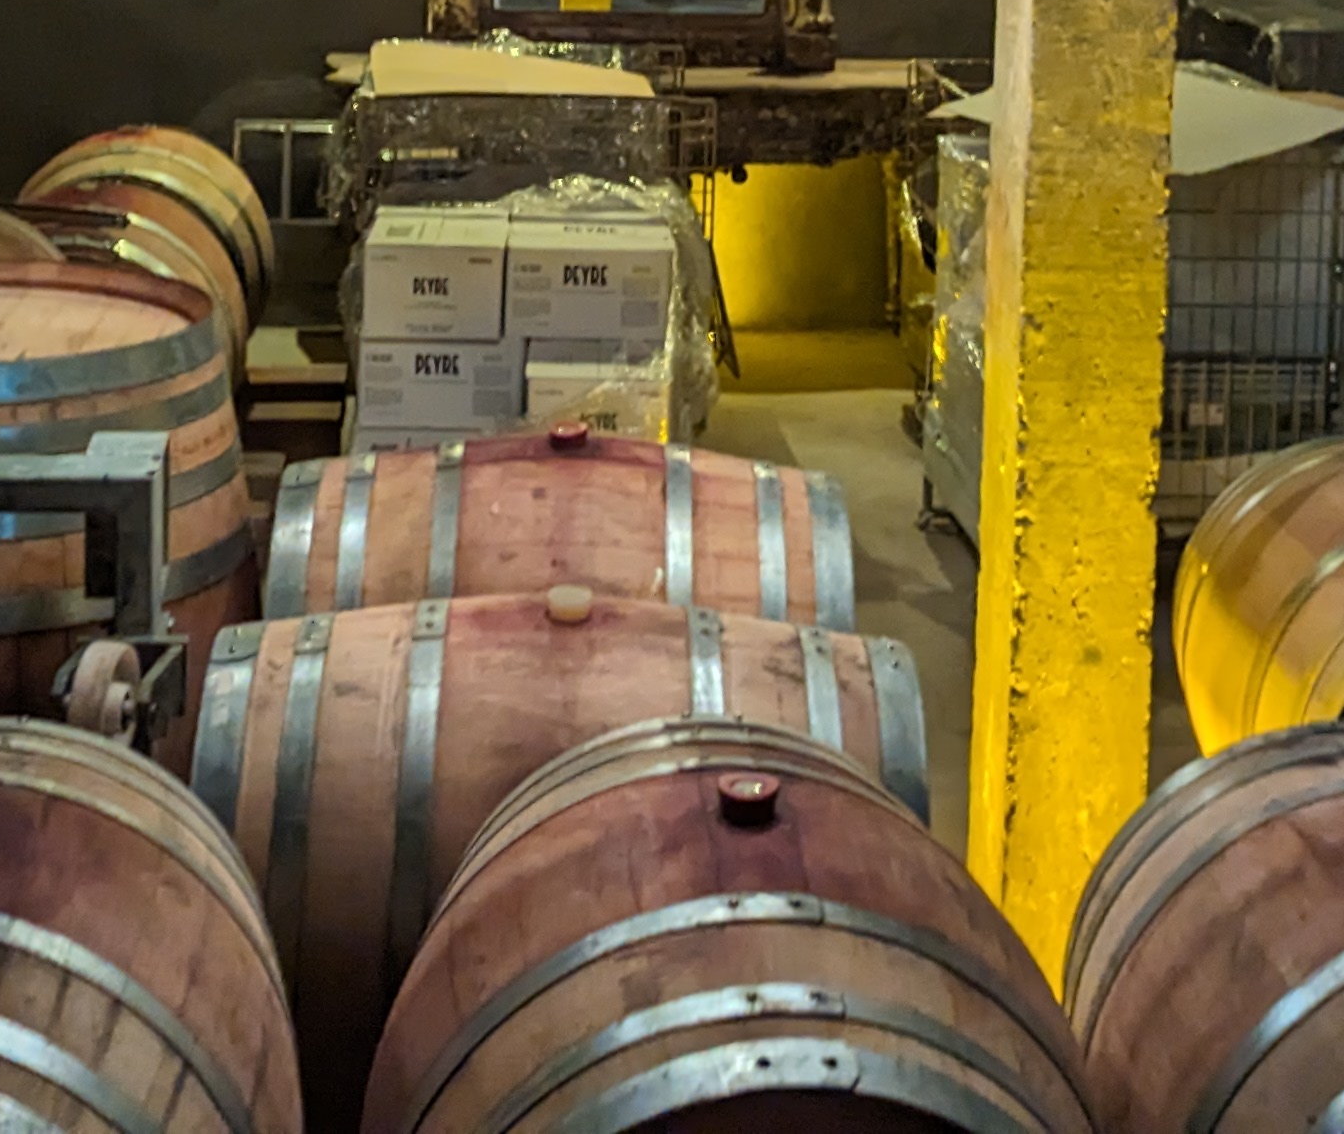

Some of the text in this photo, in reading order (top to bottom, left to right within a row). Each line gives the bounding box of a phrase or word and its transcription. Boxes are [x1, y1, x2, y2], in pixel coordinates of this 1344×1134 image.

[412, 277, 449, 296] PEYRE
[563, 264, 608, 287] PEYRE
[414, 354, 460, 376] PEYRE
